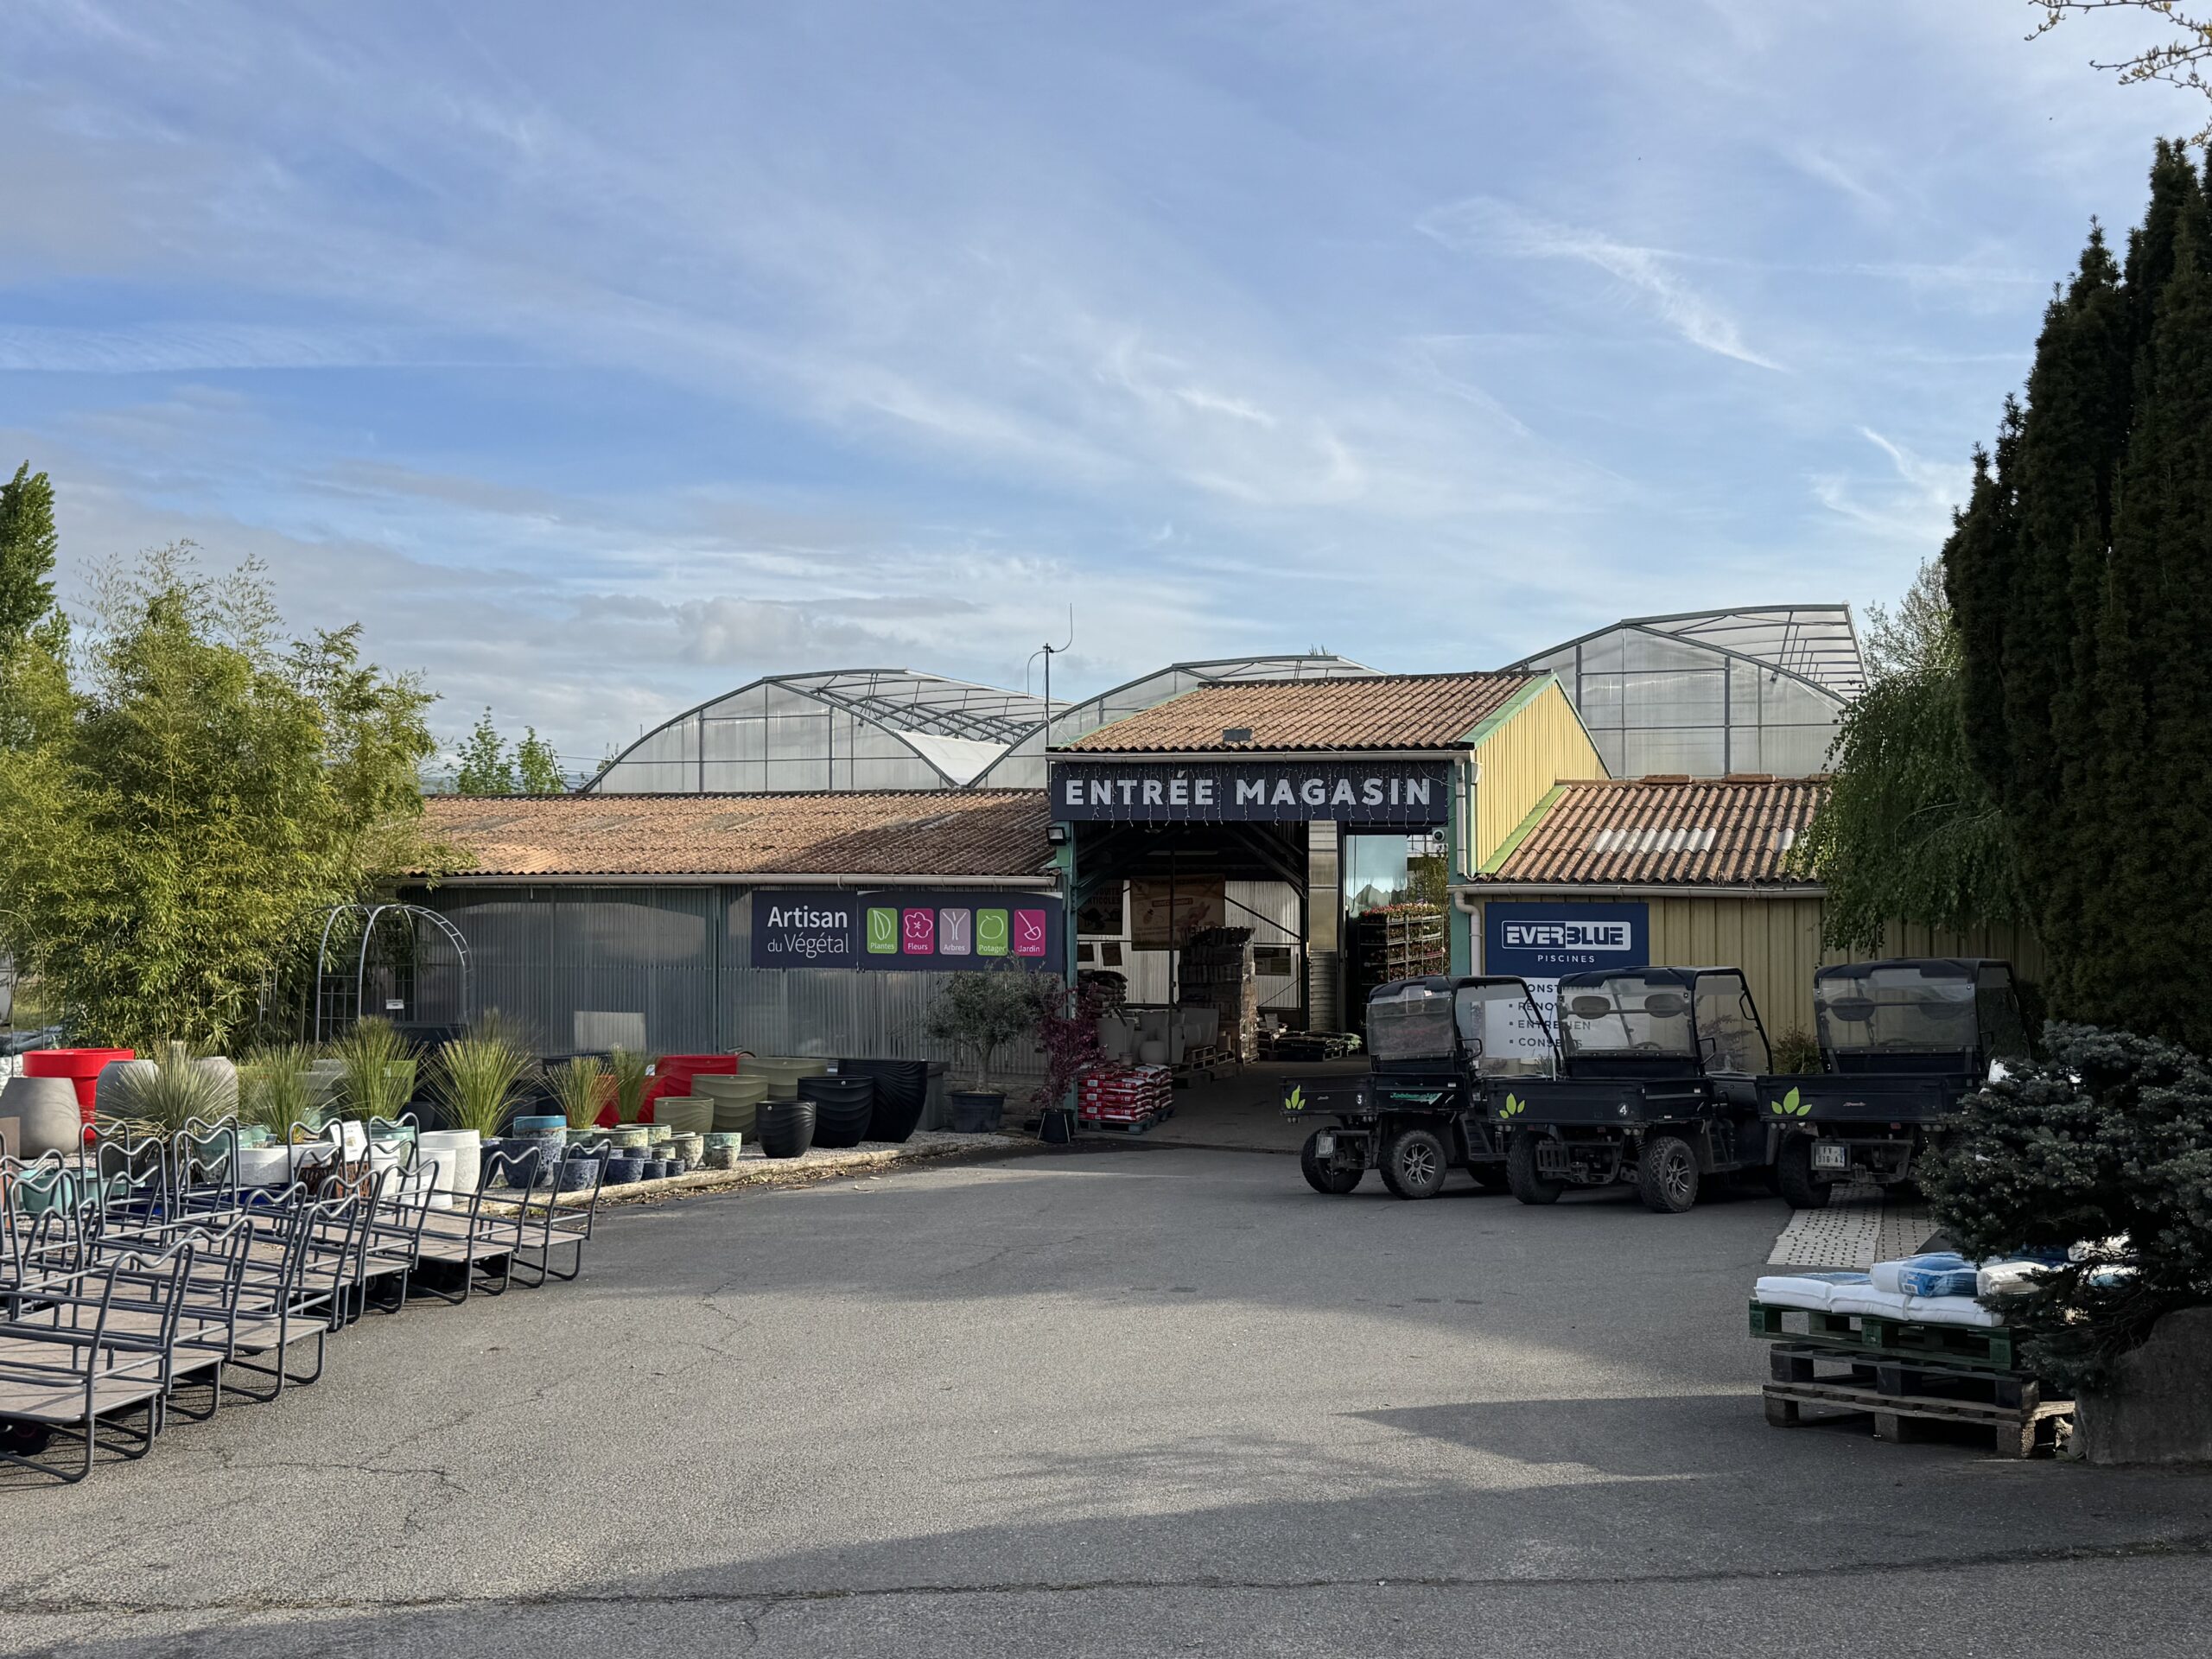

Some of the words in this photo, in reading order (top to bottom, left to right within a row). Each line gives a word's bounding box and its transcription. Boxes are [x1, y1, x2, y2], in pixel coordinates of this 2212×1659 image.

[1065, 768, 1214, 805] ENTRÉE
[1236, 778, 1430, 805] MAGASIN
[767, 906, 848, 928] Artisan
[767, 939, 783, 952] du
[784, 931, 849, 958] Végétal
[1506, 925, 1624, 945] EVERBLUE
[979, 944, 1006, 953] Potager
[1357, 1094, 1363, 1104] 3
[1620, 1103, 1628, 1115] 4
